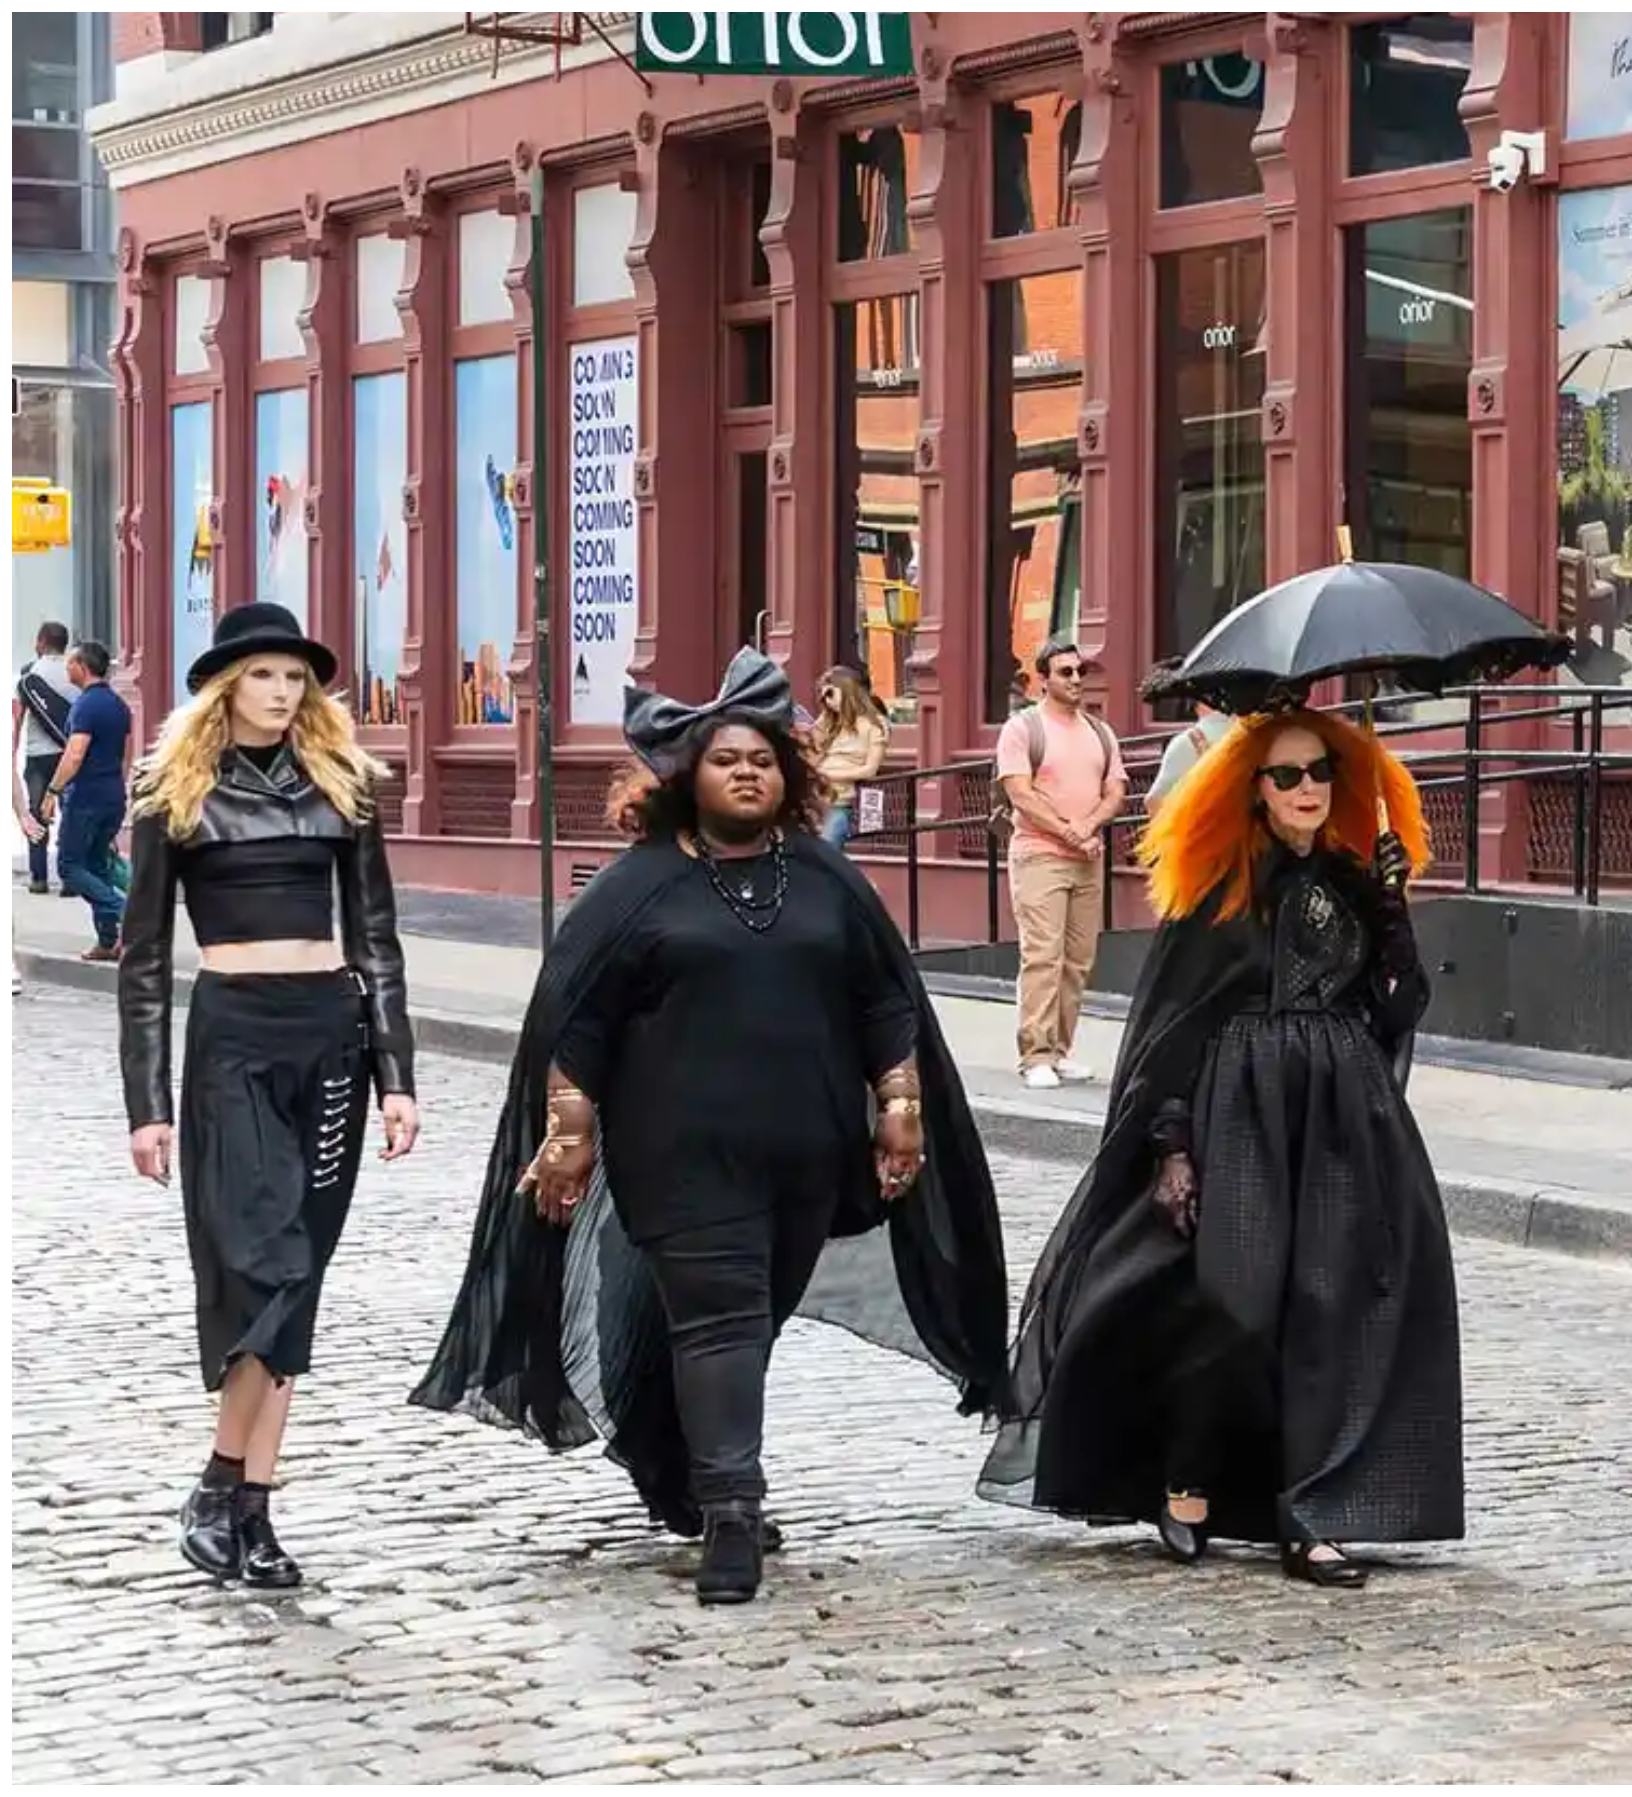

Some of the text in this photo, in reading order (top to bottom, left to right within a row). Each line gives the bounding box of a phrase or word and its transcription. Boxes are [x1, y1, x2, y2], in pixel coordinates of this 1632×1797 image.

[1400, 296, 1436, 324] orior
[1203, 321, 1235, 348] orior
[573, 424, 633, 459] COMING
[573, 500, 633, 532] COMING
[573, 538, 616, 568] SOON
[573, 574, 633, 605] COMING
[573, 611, 616, 642] SOON
